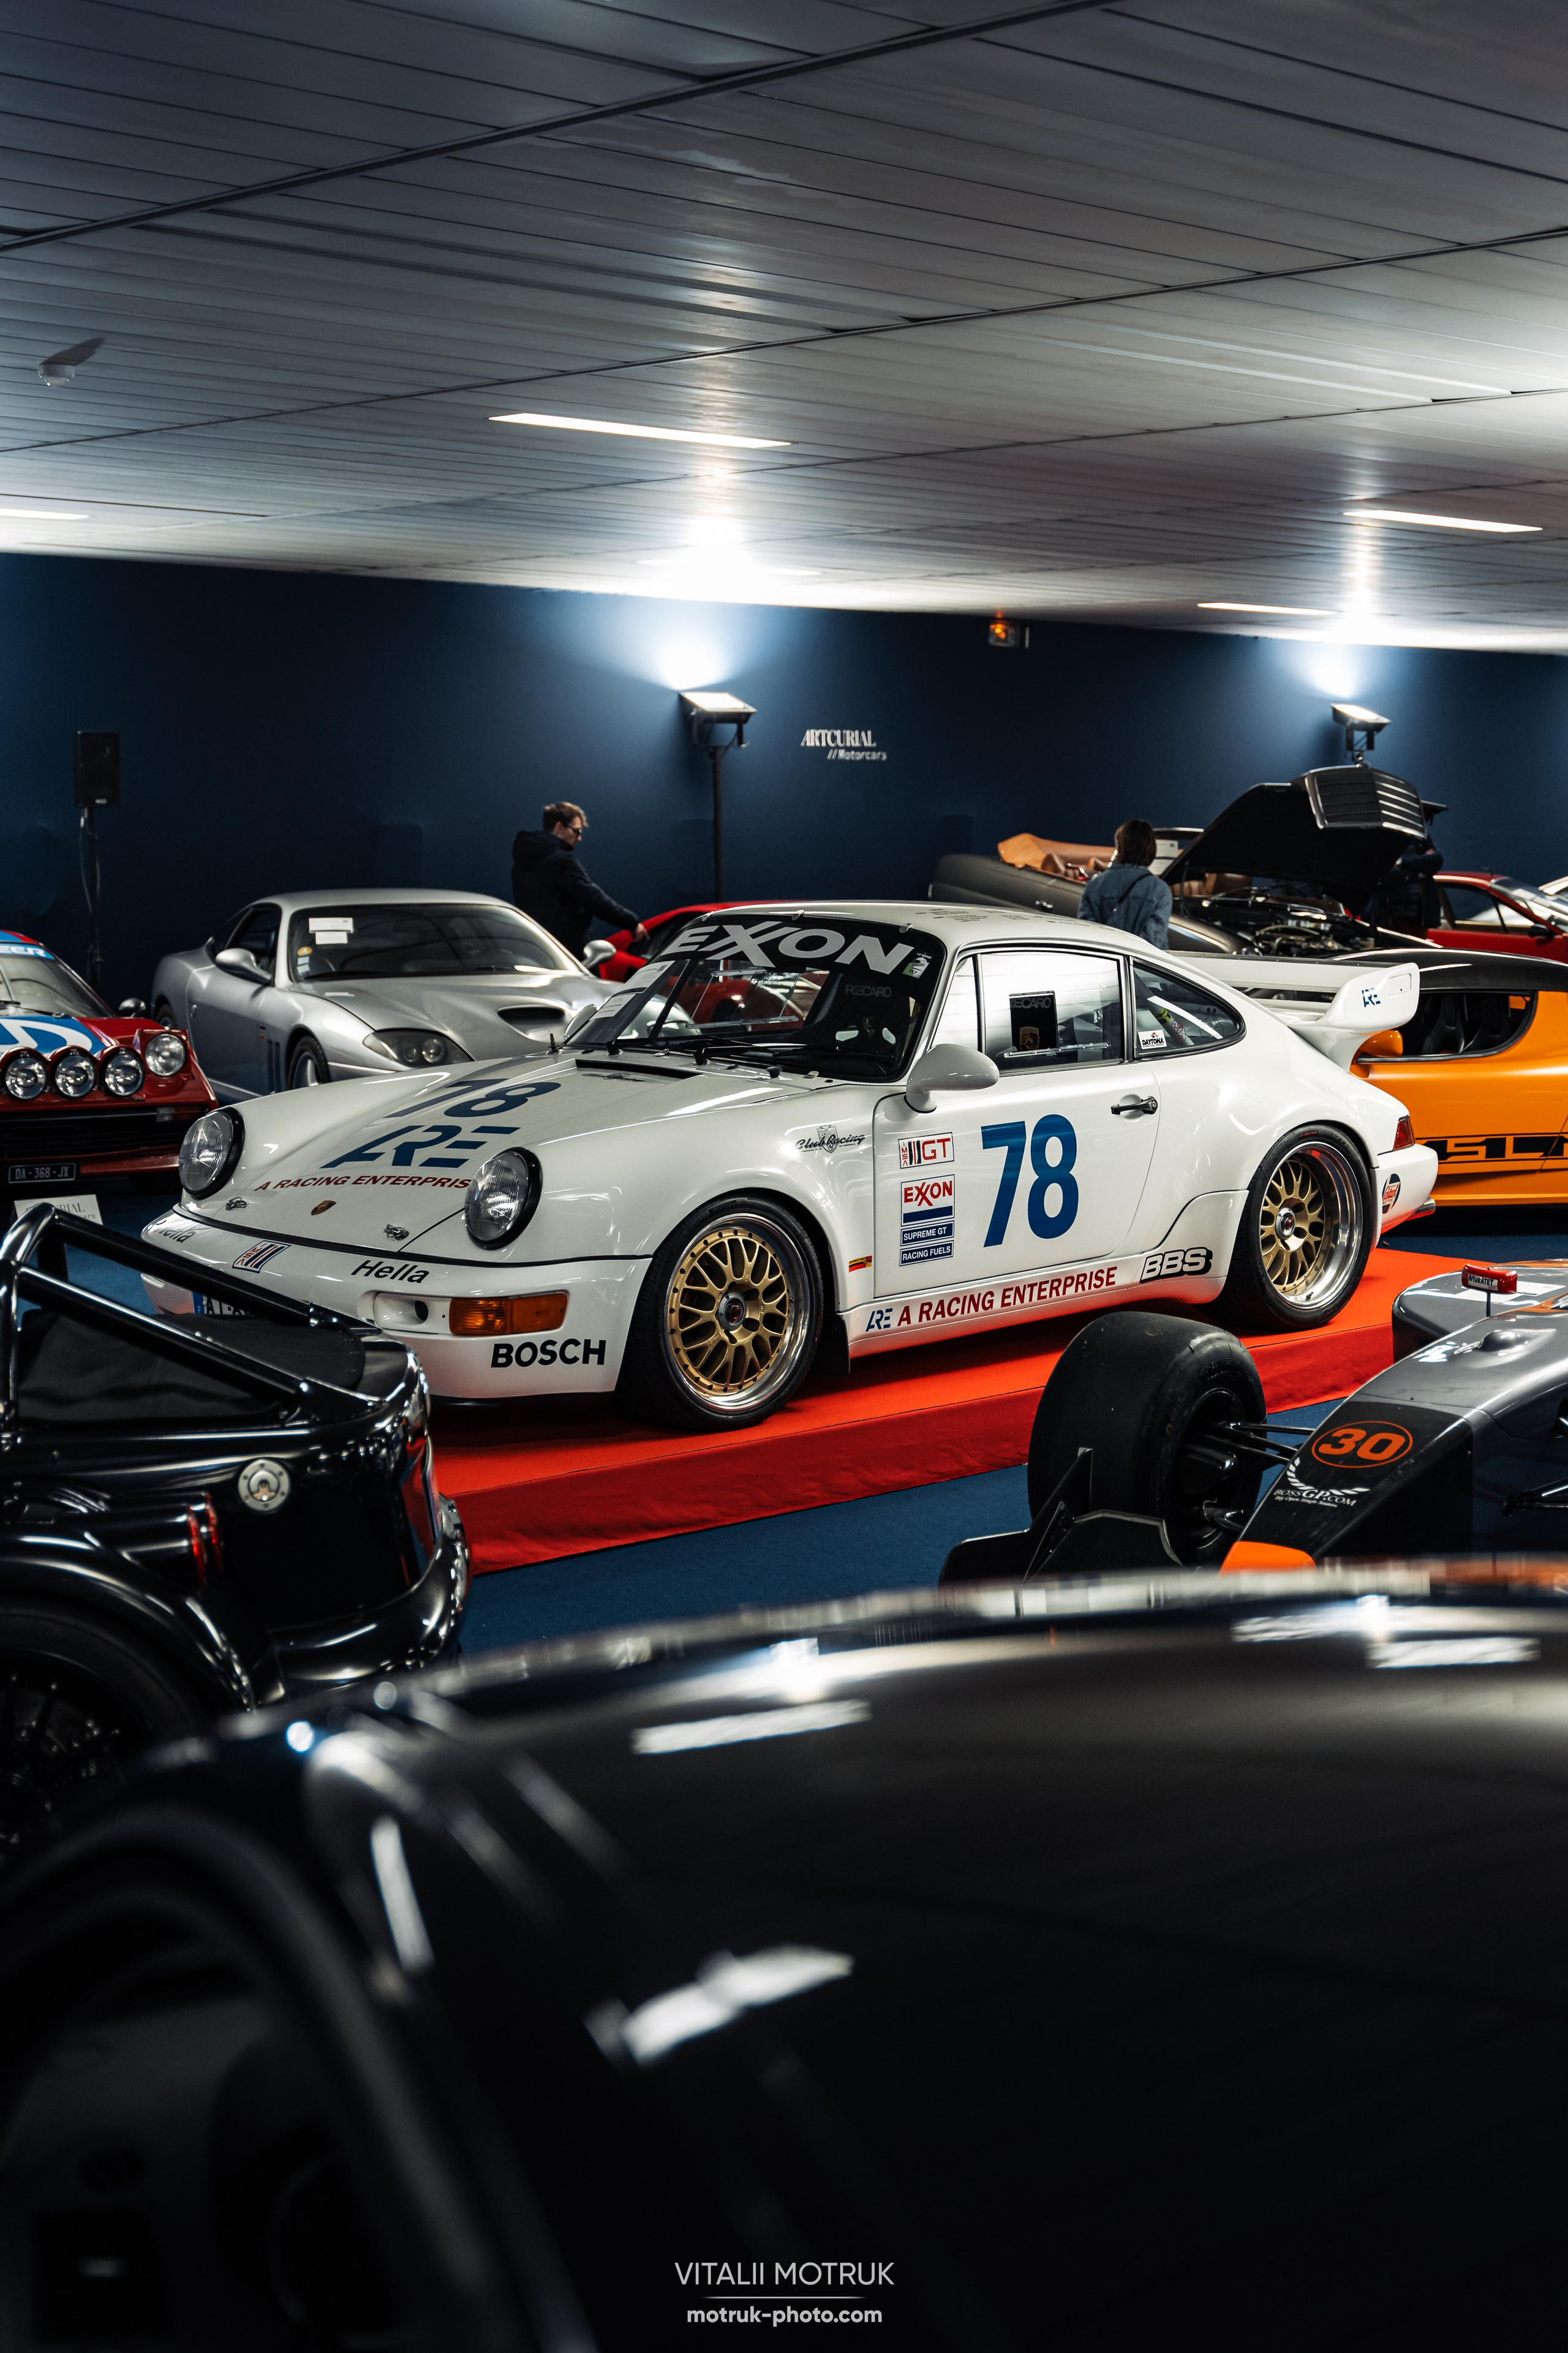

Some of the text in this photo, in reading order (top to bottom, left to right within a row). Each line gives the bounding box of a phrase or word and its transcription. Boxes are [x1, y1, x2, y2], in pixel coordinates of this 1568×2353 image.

[801, 729, 876, 747] ARTCURIAL
[845, 984, 892, 997] RECARO
[382, 1078, 562, 1118] 78
[796, 1134, 865, 1149] Club Racing
[922, 1138, 951, 1160] GT
[254, 1175, 472, 1191] A RACING ENTERPRIS
[981, 1114, 1079, 1248] 78
[904, 1180, 952, 1207] EXXON
[903, 1226, 947, 1241] SUPREME GT
[902, 1245, 951, 1261] RACING FUELS
[351, 1260, 429, 1283] Hella
[1139, 1246, 1213, 1283] BBS
[1468, 1274, 1494, 1286] MURATET
[897, 1305, 911, 1326] A
[918, 1292, 994, 1323] RACING
[1000, 1266, 1118, 1309] ENTERPRISE
[491, 1339, 606, 1368] BOSCH
[1318, 1428, 1405, 1461] 30
